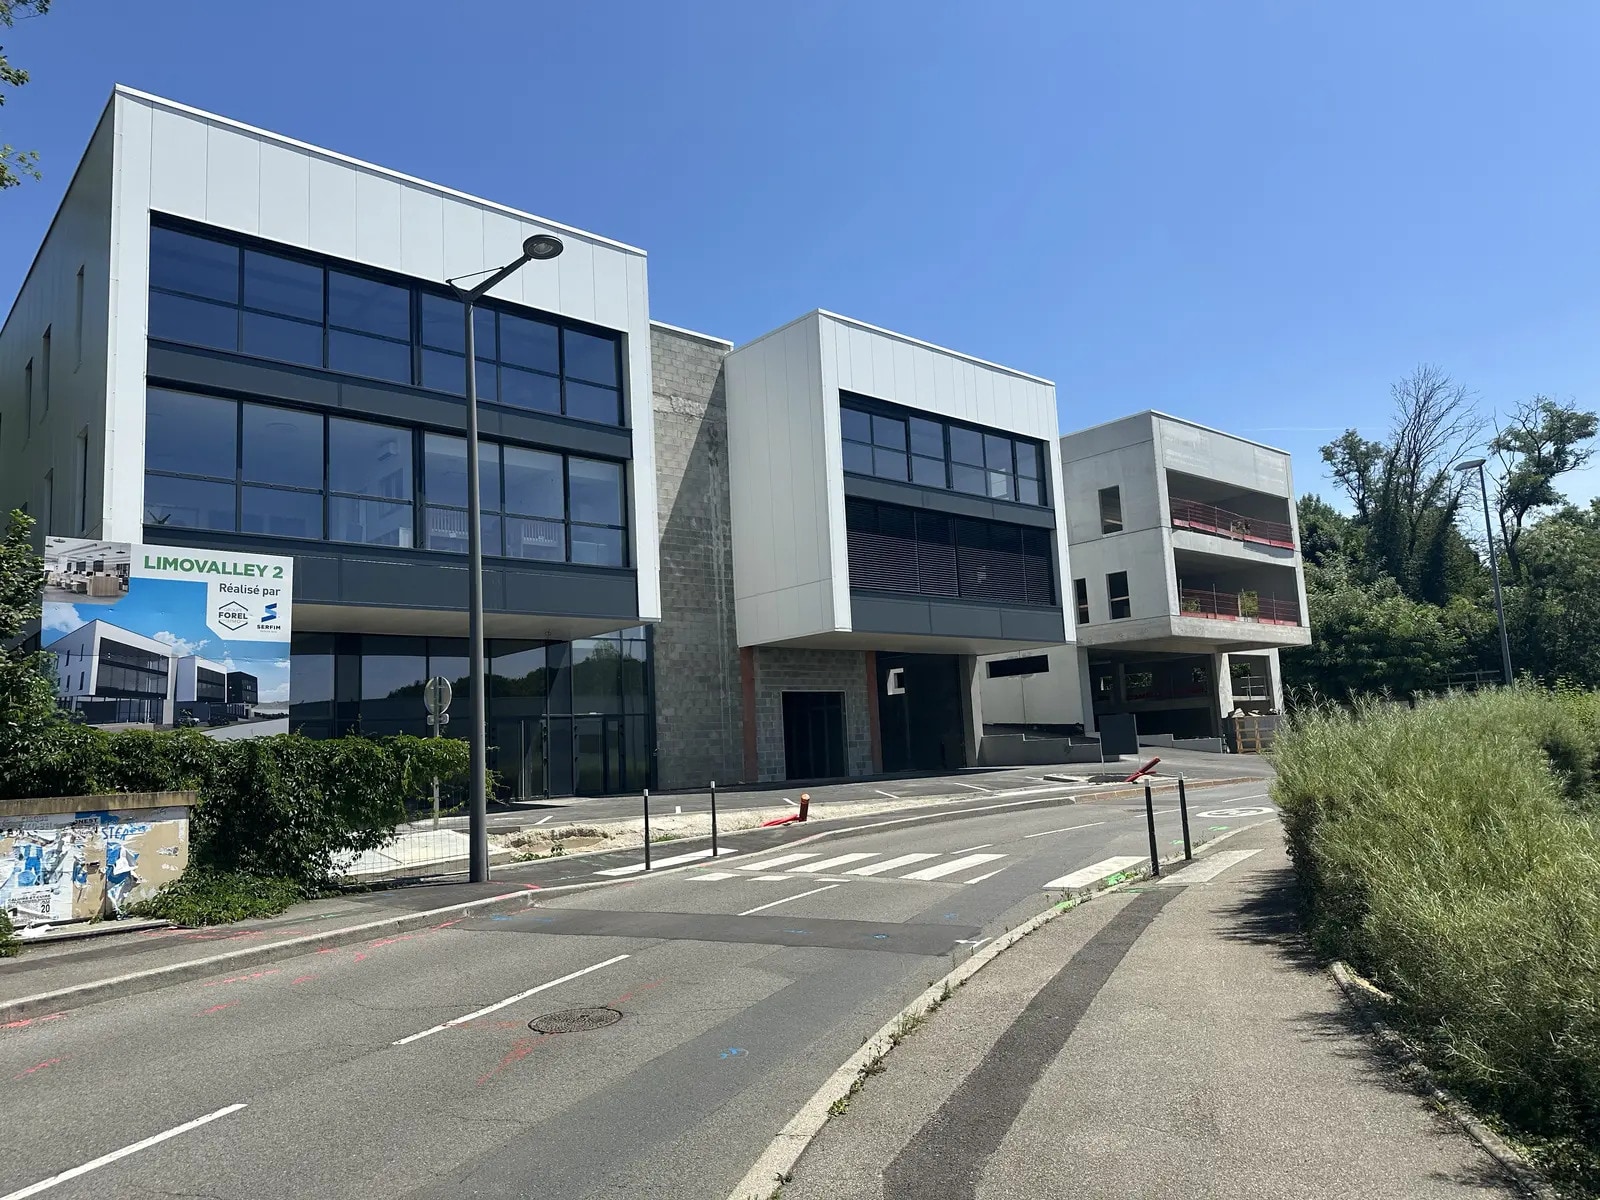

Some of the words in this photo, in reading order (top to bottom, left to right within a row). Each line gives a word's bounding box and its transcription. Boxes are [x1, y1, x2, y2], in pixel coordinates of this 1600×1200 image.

[144, 555, 268, 578] LIMOVALLEY
[272, 565, 284, 579] 2
[219, 583, 260, 595] Réalisé
[262, 588, 281, 597] par
[218, 612, 248, 620] FOREL
[41, 904, 50, 913] 20
